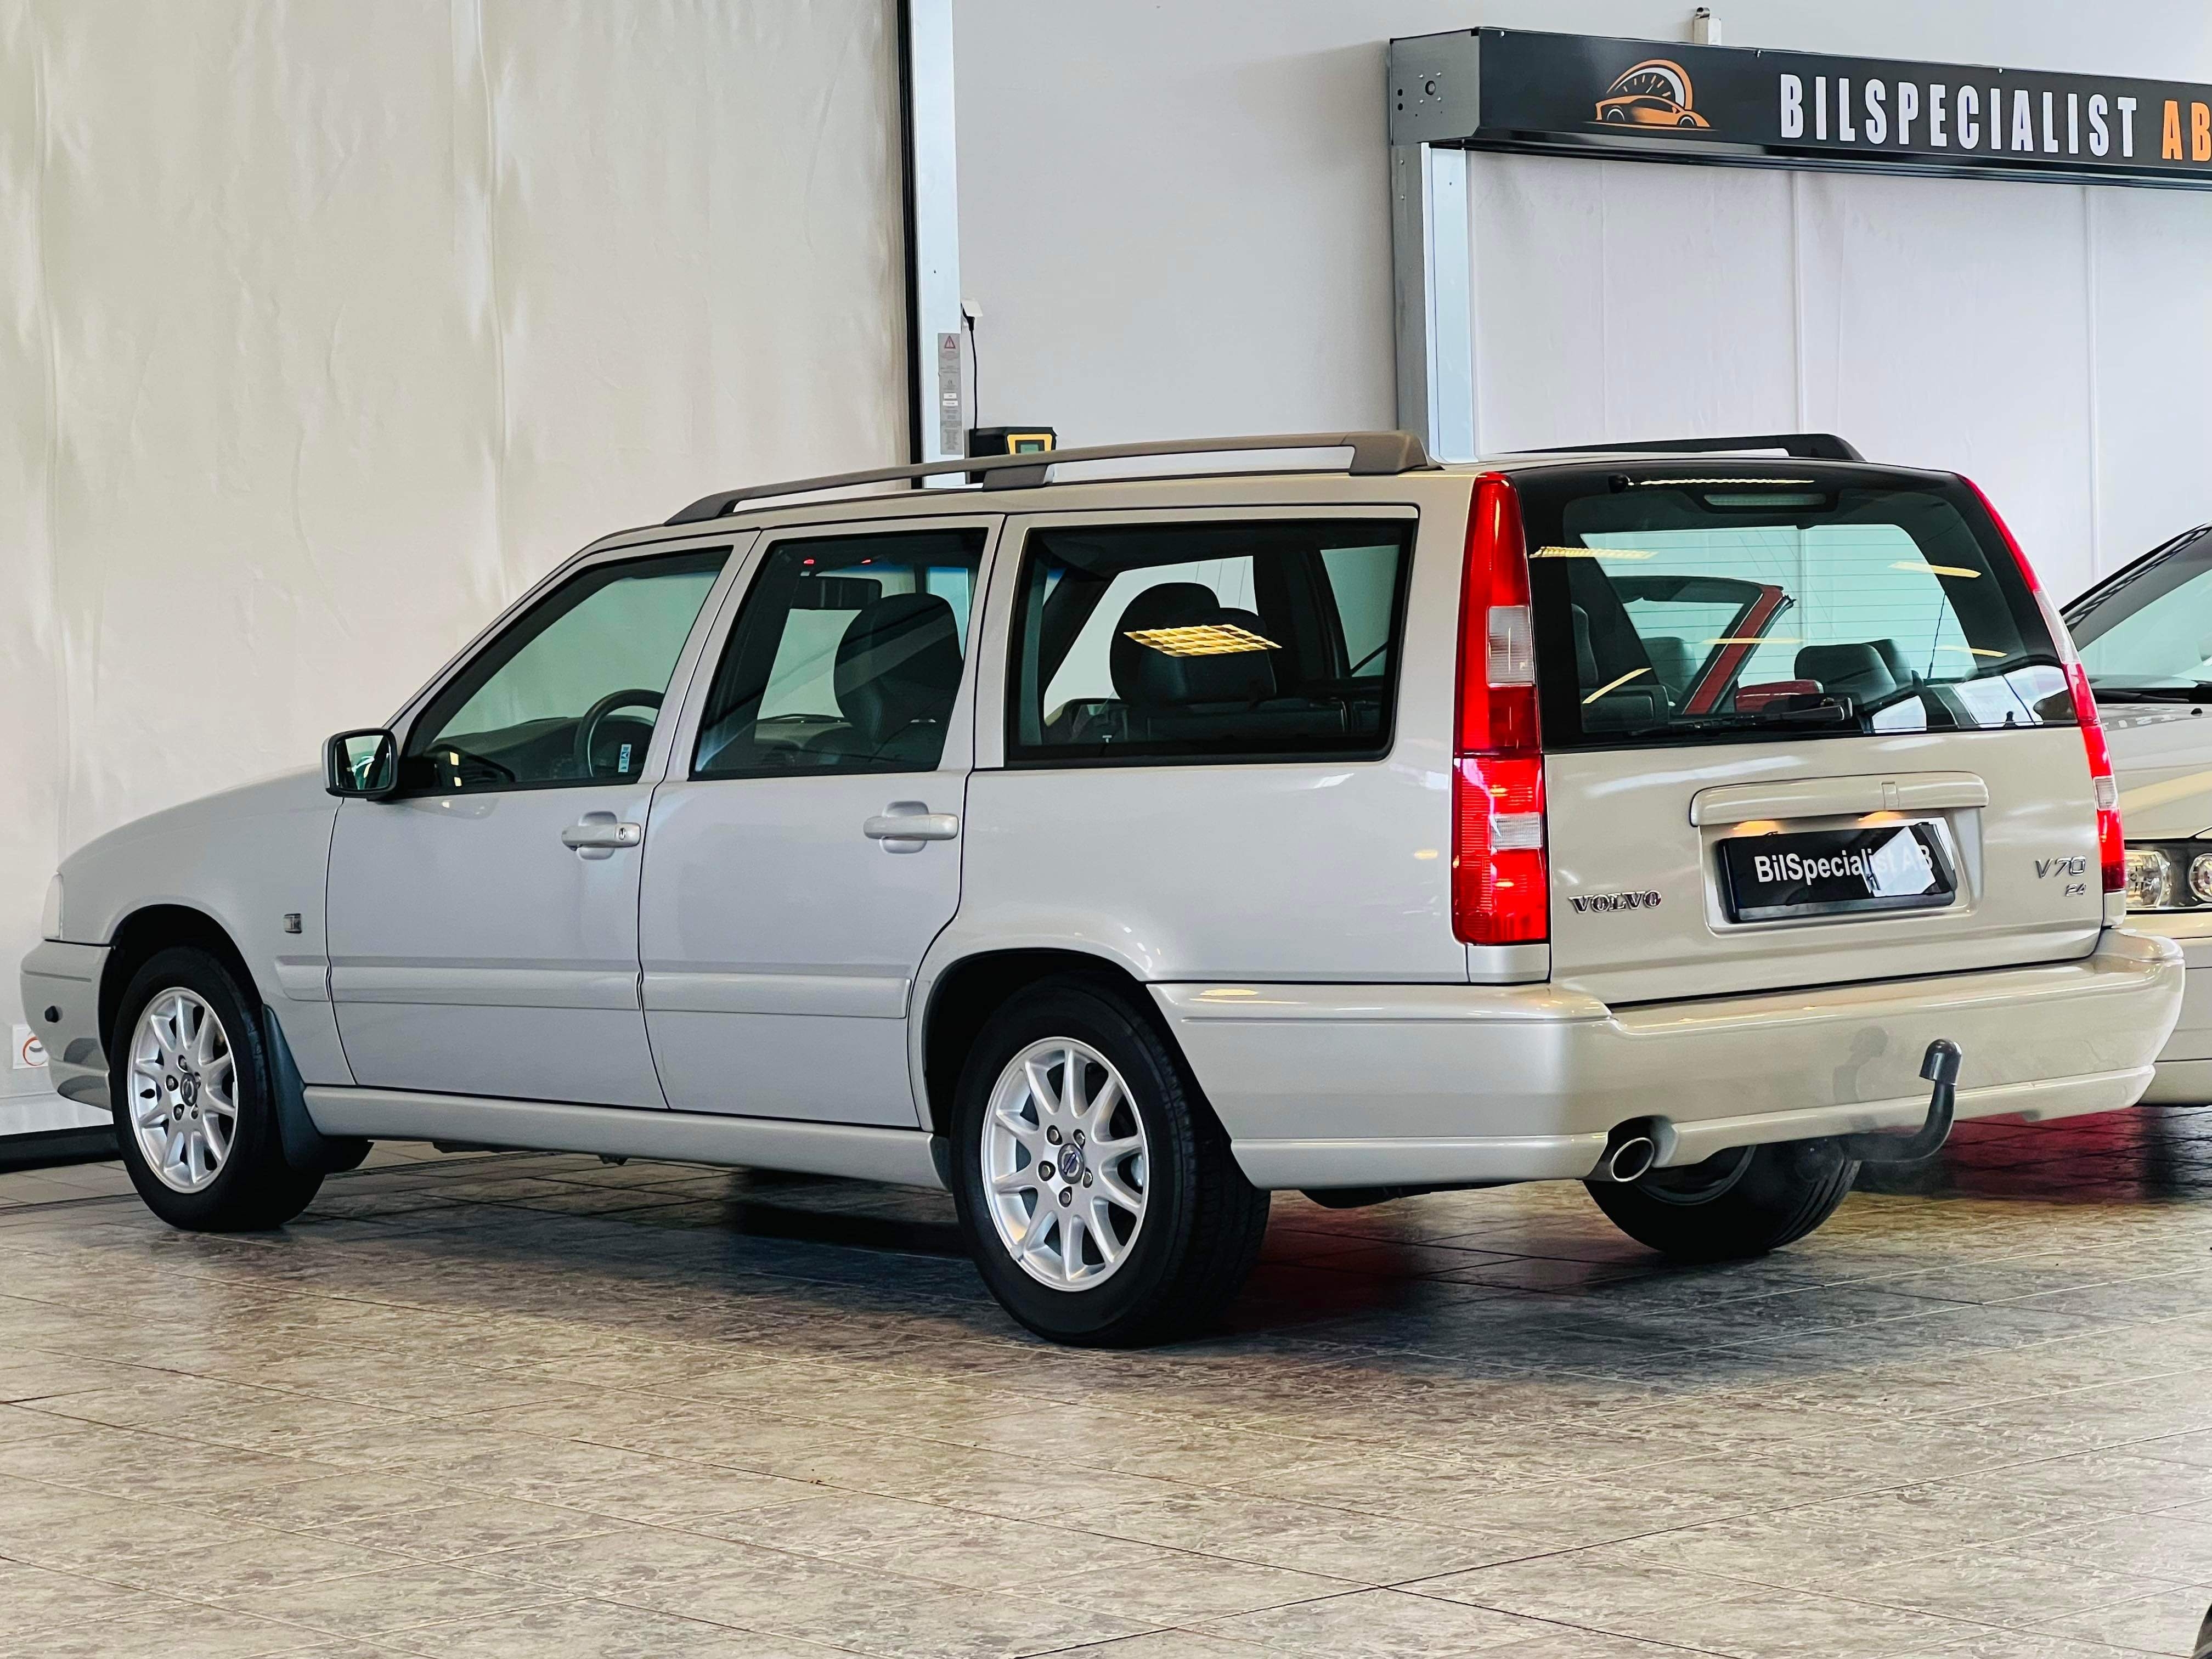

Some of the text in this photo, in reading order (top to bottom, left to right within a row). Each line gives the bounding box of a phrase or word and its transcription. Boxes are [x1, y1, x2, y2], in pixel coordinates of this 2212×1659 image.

[1780, 74, 2211, 161] BILSPECIALIST AB
[2035, 855, 2086, 878] V70
[1568, 890, 1662, 914] VOLVO
